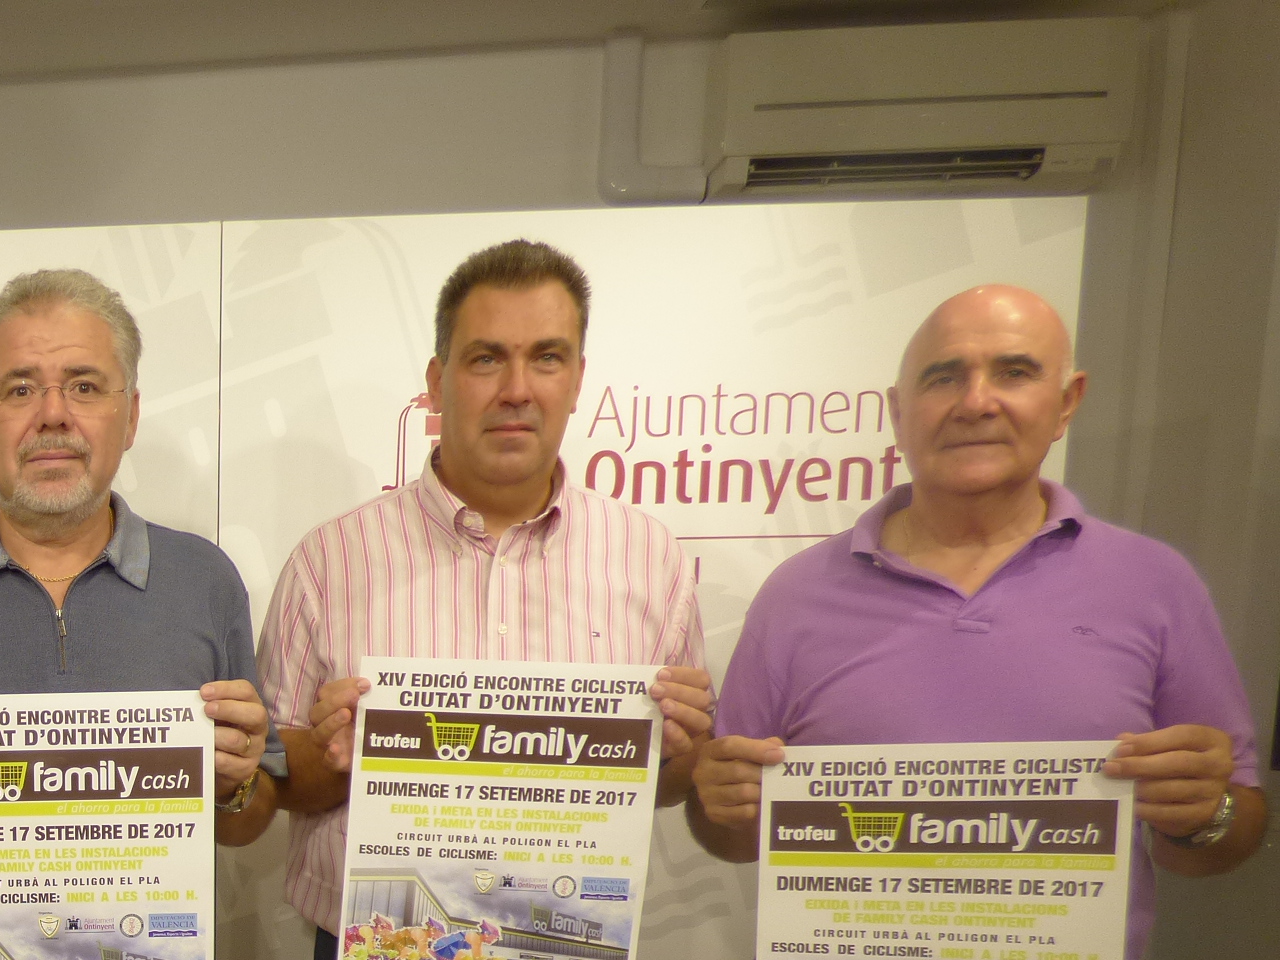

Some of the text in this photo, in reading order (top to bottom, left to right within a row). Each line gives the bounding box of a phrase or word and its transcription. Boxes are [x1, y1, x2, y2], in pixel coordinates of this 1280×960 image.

[587, 383, 884, 453] Ajuntamen
[585, 443, 902, 514] Ontinyent
[376, 671, 648, 695] XIV EDICIÓ ENCONTRE CICLISTA
[399, 690, 623, 714] CIUTAT D'ONTINYENT
[17, 709, 110, 725] ENCONTRE
[116, 707, 194, 723] CICLISTA
[24, 727, 170, 746] D'ONTINYENT
[370, 724, 637, 764] trofeu family cash
[781, 762, 815, 777] XIV
[821, 757, 886, 776] EDICIÓ
[894, 760, 1005, 776] ENCONTRE
[33, 760, 140, 798] family
[141, 769, 190, 790] cash
[809, 778, 1079, 797] CIUTAT D'ONTINYENT
[366, 781, 637, 806] DIUMENGE 17 SETEMBRE DE 2017
[9, 826, 30, 841] 17
[35, 824, 123, 841] SETEMBRE
[128, 824, 149, 839] DE
[154, 823, 195, 838] 2017
[397, 832, 596, 849] CIRCUIT URBÀ AL POLIGON EL PLA
[778, 812, 1099, 852] trofeu family cash
[35, 849, 51, 859] EN
[55, 848, 77, 859] LES
[81, 846, 168, 858] INSTALACIONS
[39, 861, 72, 872] CASH
[75, 859, 143, 871] ONTINYENT
[8, 877, 39, 887] URBÀ
[44, 878, 58, 887] AL
[64, 877, 113, 886] POLIGON
[120, 877, 133, 885] EL
[139, 876, 160, 885] PLA
[777, 875, 1104, 897] DIUMENGE 17 SETEMBRE DE 2017
[0, 893, 60, 904] CICLISME:
[67, 892, 94, 902] INICI
[101, 892, 109, 902] A
[116, 892, 138, 902] LES
[146, 890, 180, 901] 10:00
[186, 890, 197, 900] H.
[814, 929, 1055, 945] CIRCUIT URBÀ AL POLIGON EL PLA
